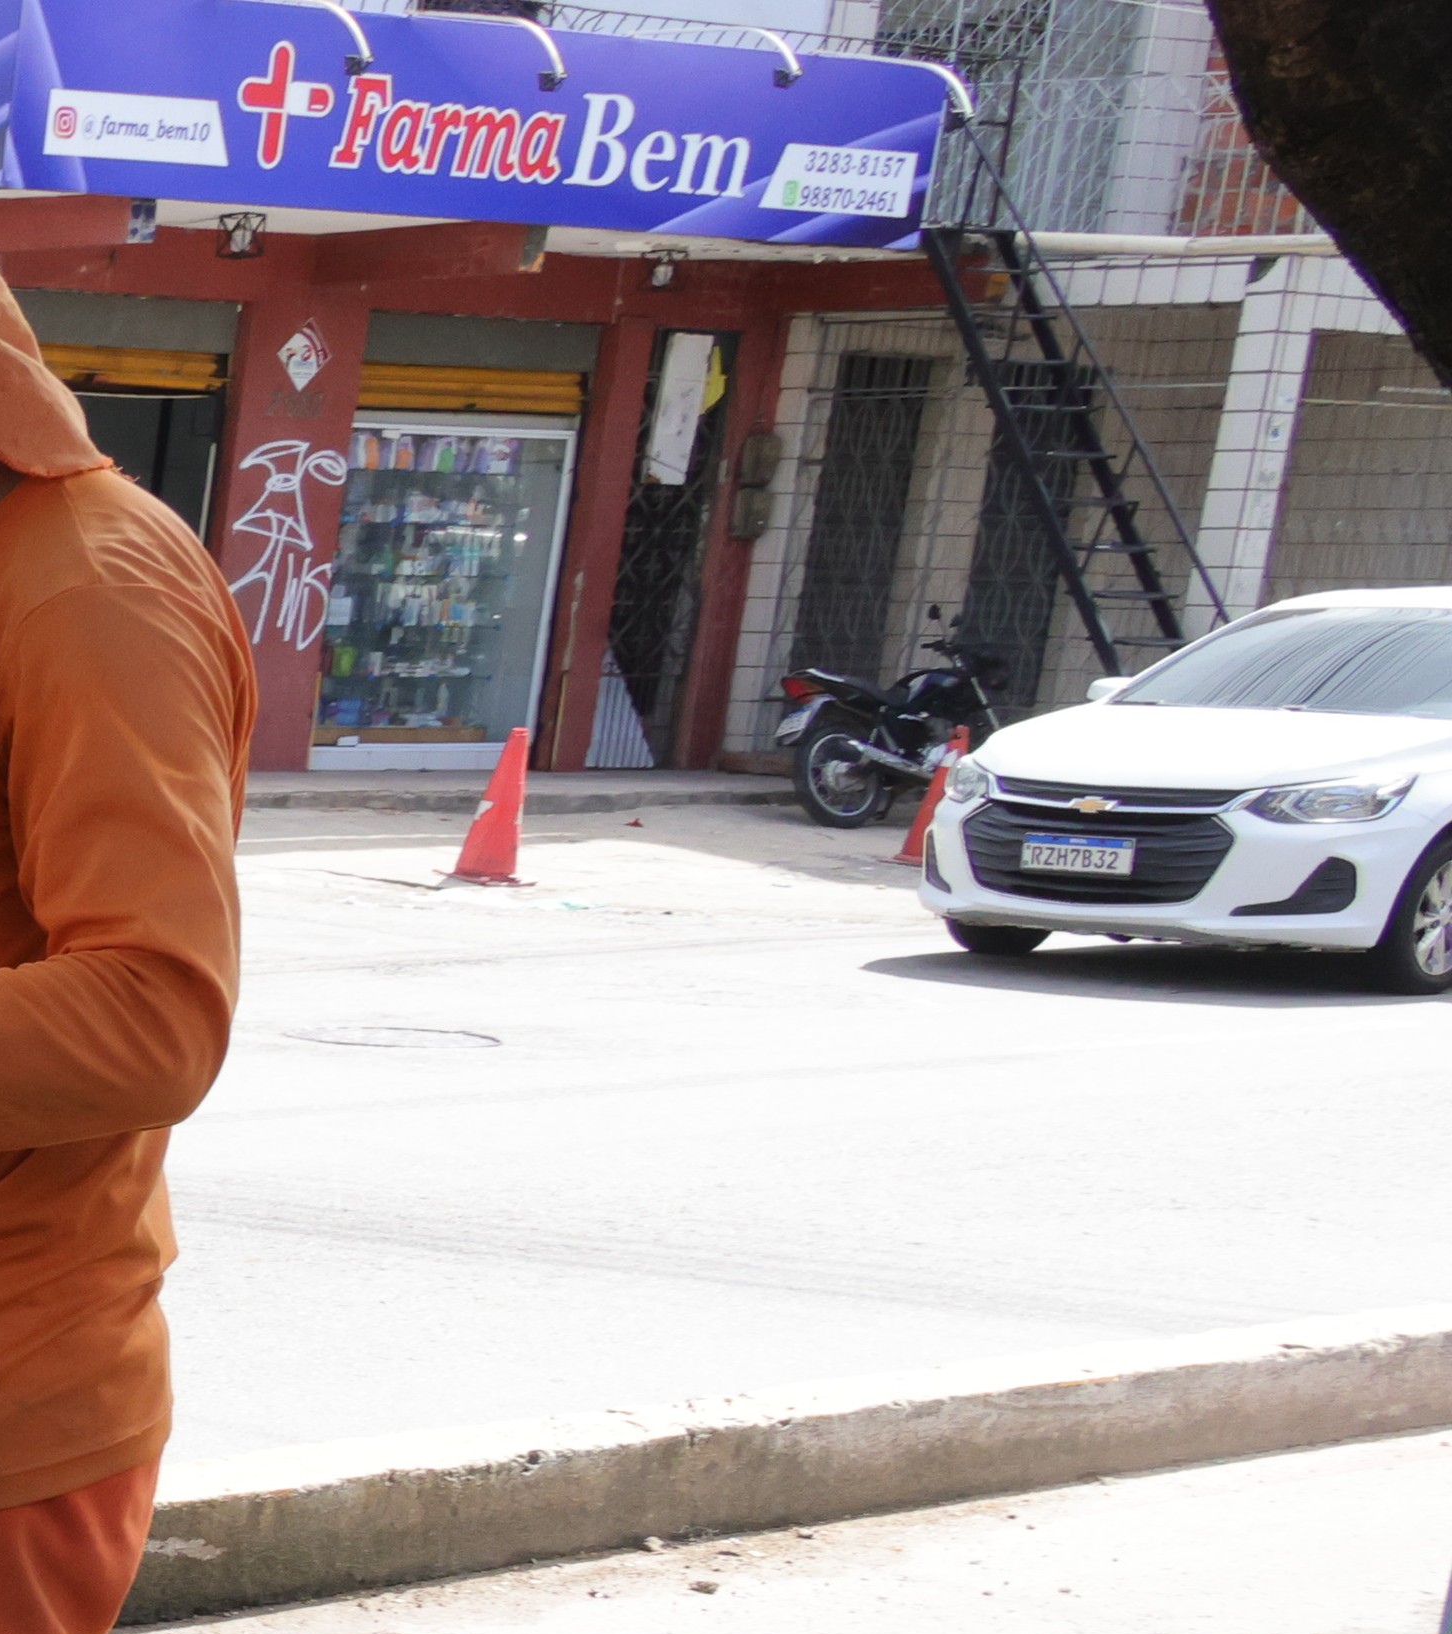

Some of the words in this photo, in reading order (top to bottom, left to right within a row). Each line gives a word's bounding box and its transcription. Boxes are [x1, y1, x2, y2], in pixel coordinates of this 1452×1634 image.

[329, 72, 566, 184] Farma
[563, 92, 751, 198] Bem
[804, 150, 906, 179] 3283-8157
[798, 184, 898, 213] 98870-2461
[1031, 846, 1119, 870] RZH7B32
